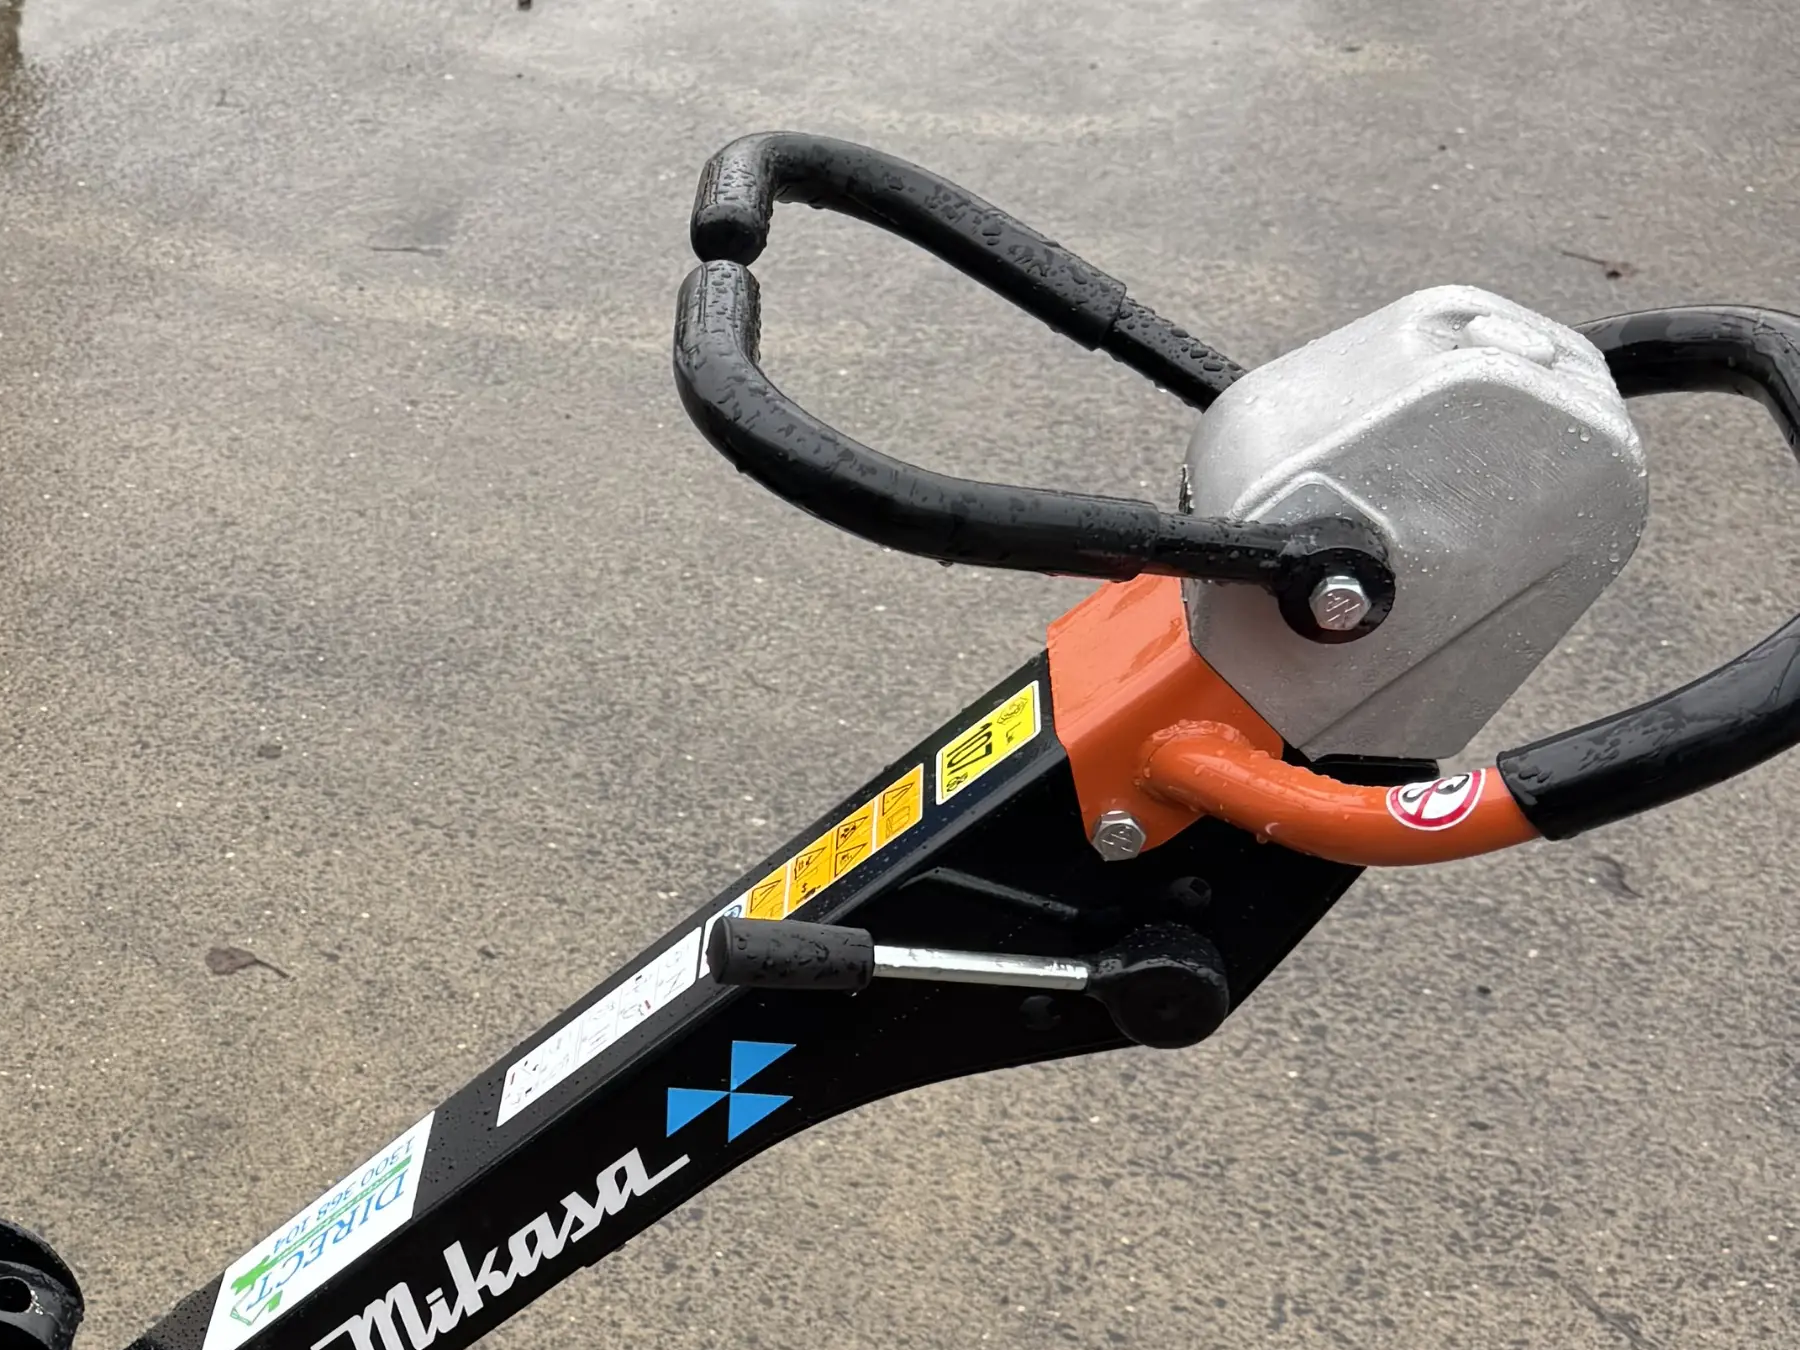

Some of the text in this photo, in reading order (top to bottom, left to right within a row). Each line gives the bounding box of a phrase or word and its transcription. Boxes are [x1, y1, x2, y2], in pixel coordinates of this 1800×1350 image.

[946, 722, 993, 776] 107
[360, 1135, 416, 1189] 1300
[316, 1180, 357, 1222] 368
[246, 1168, 409, 1312] DIRECT
[273, 1216, 310, 1254] 104
